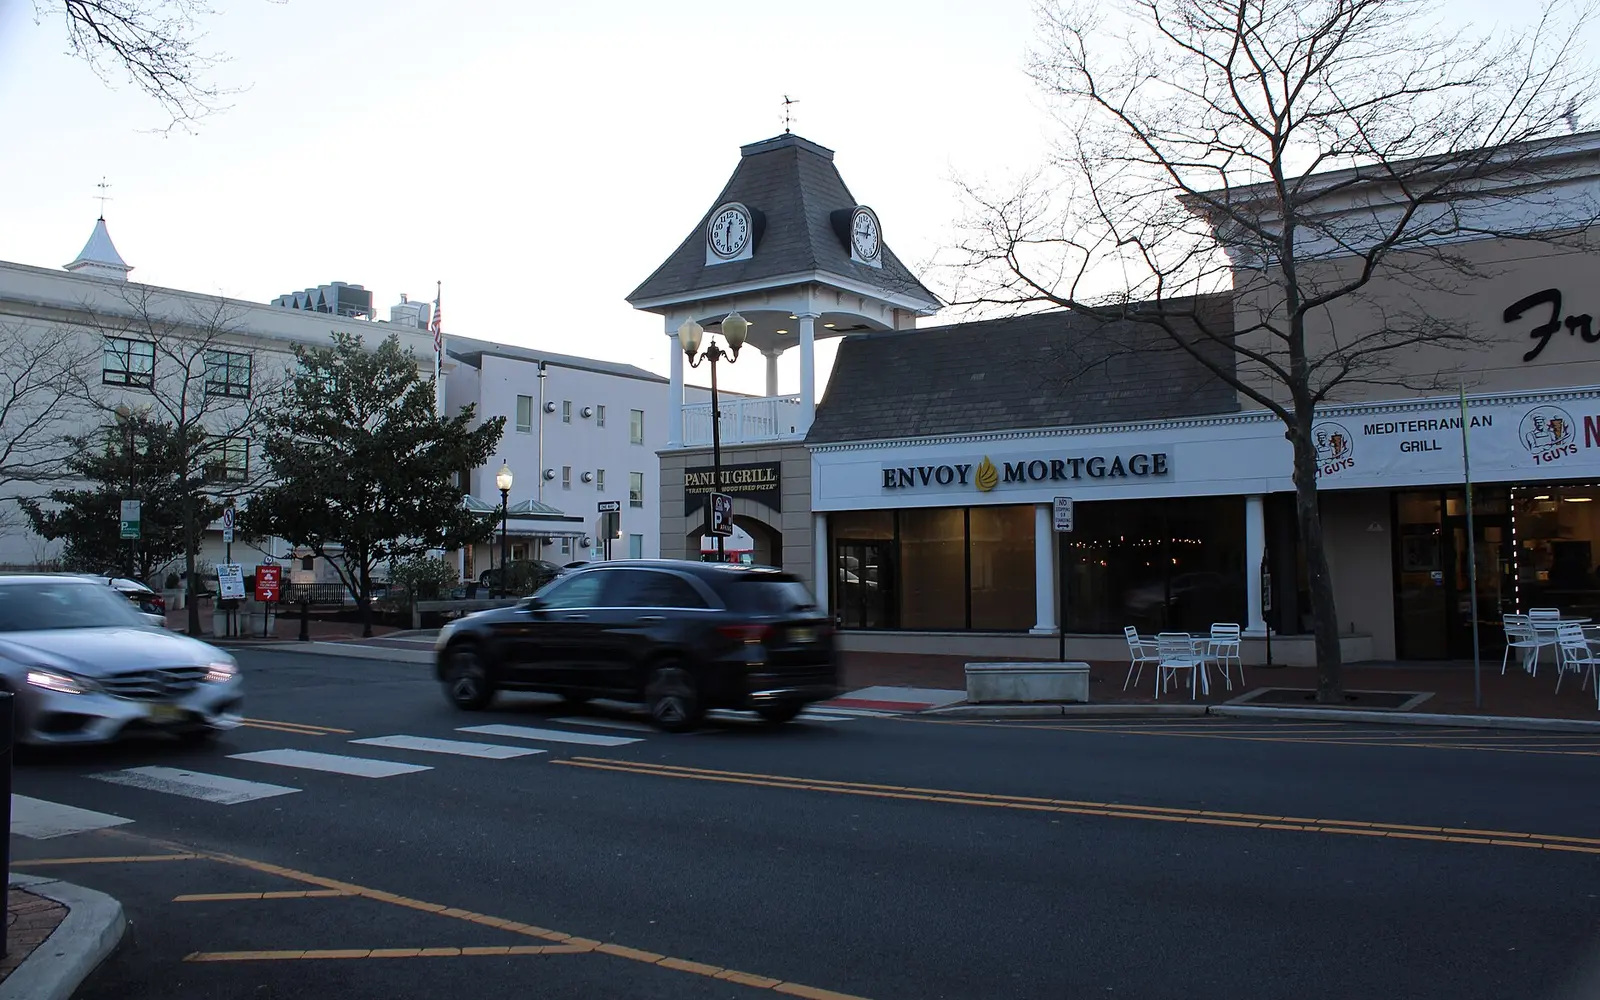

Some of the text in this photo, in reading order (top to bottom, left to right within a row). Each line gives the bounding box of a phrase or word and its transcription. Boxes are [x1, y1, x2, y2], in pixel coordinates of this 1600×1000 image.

[726, 211, 734, 219] 12
[1363, 415, 1493, 435] MEDITERRANAN
[1399, 439, 1442, 453] GRILL
[1542, 444, 1578, 462] GUYS
[882, 453, 1168, 488] ENVOY MORTGAGE
[1324, 457, 1355, 475] GUYS
[732, 468, 776, 484] GRILL
[1058, 499, 1068, 507] NO
